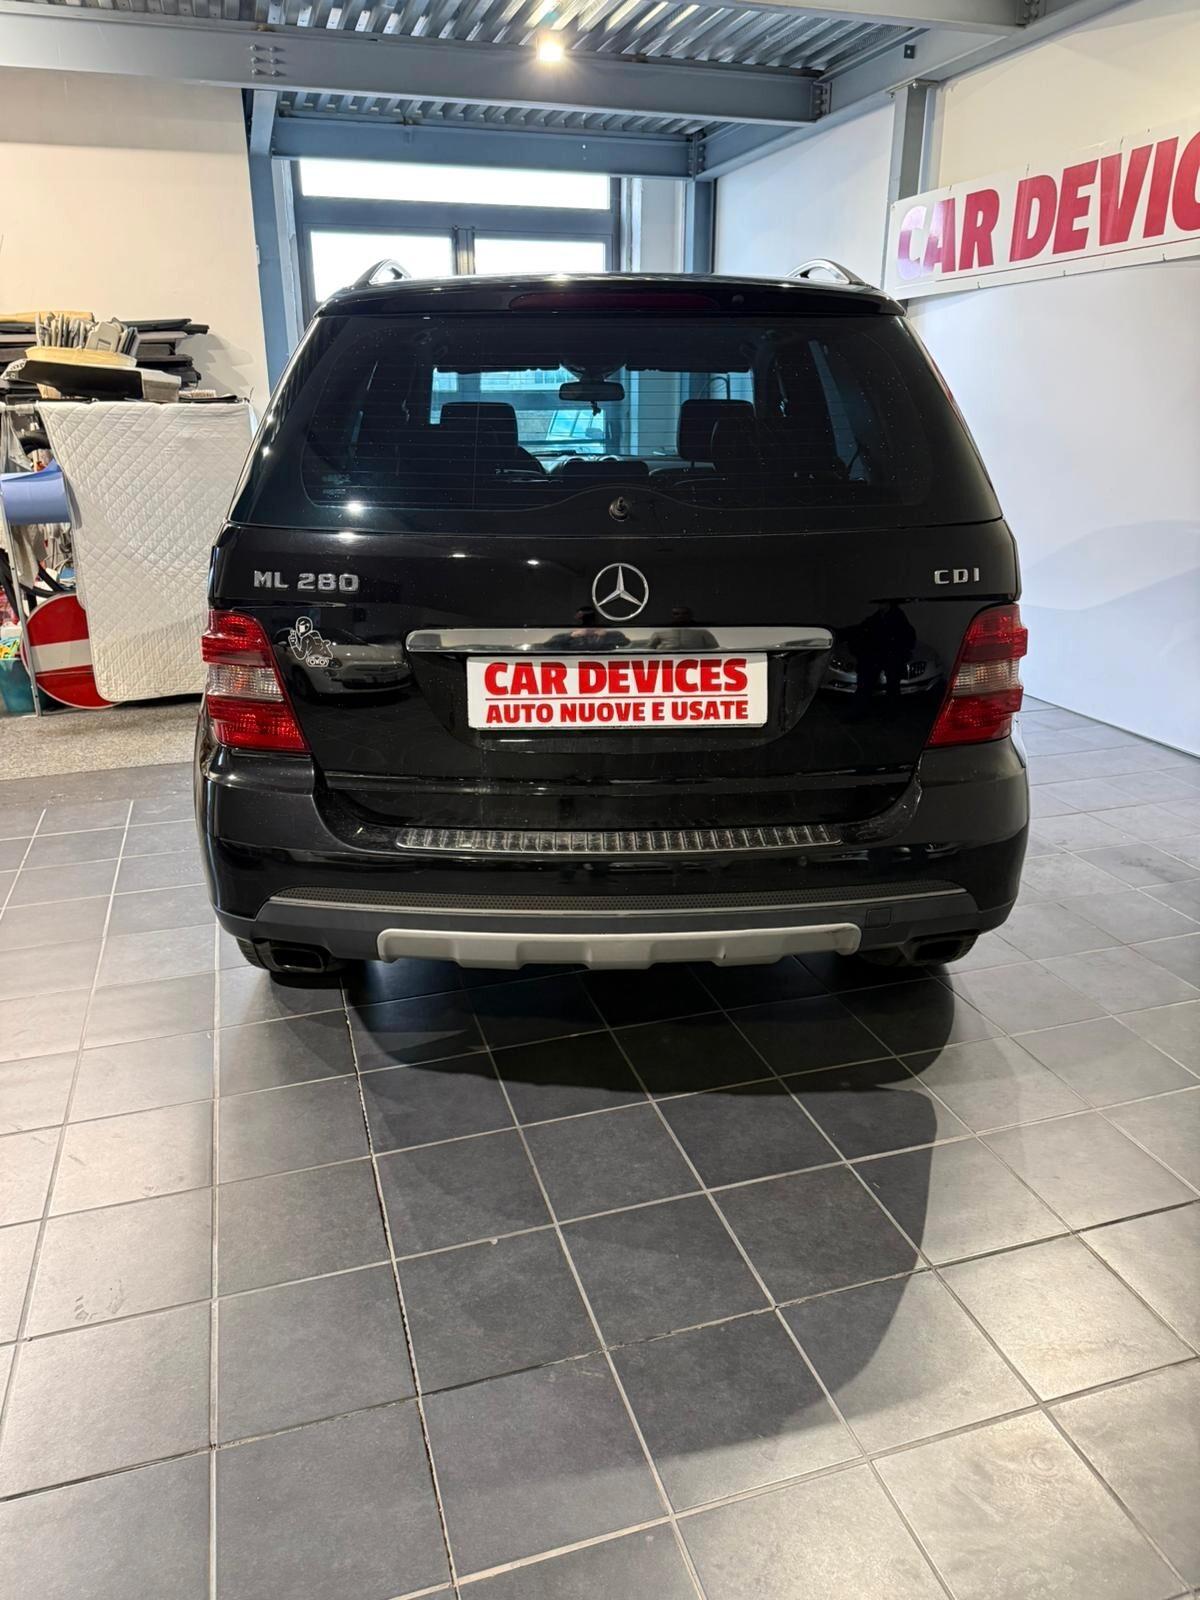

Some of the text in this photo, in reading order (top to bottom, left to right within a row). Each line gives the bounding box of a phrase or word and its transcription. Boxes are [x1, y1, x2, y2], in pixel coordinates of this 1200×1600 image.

[897, 188, 1000, 281] CAR
[253, 570, 359, 592] ML 280
[934, 567, 980, 585] CDI
[484, 658, 748, 695] CAR DEVICES
[486, 700, 749, 723] AUTO NUOVE E USATE
